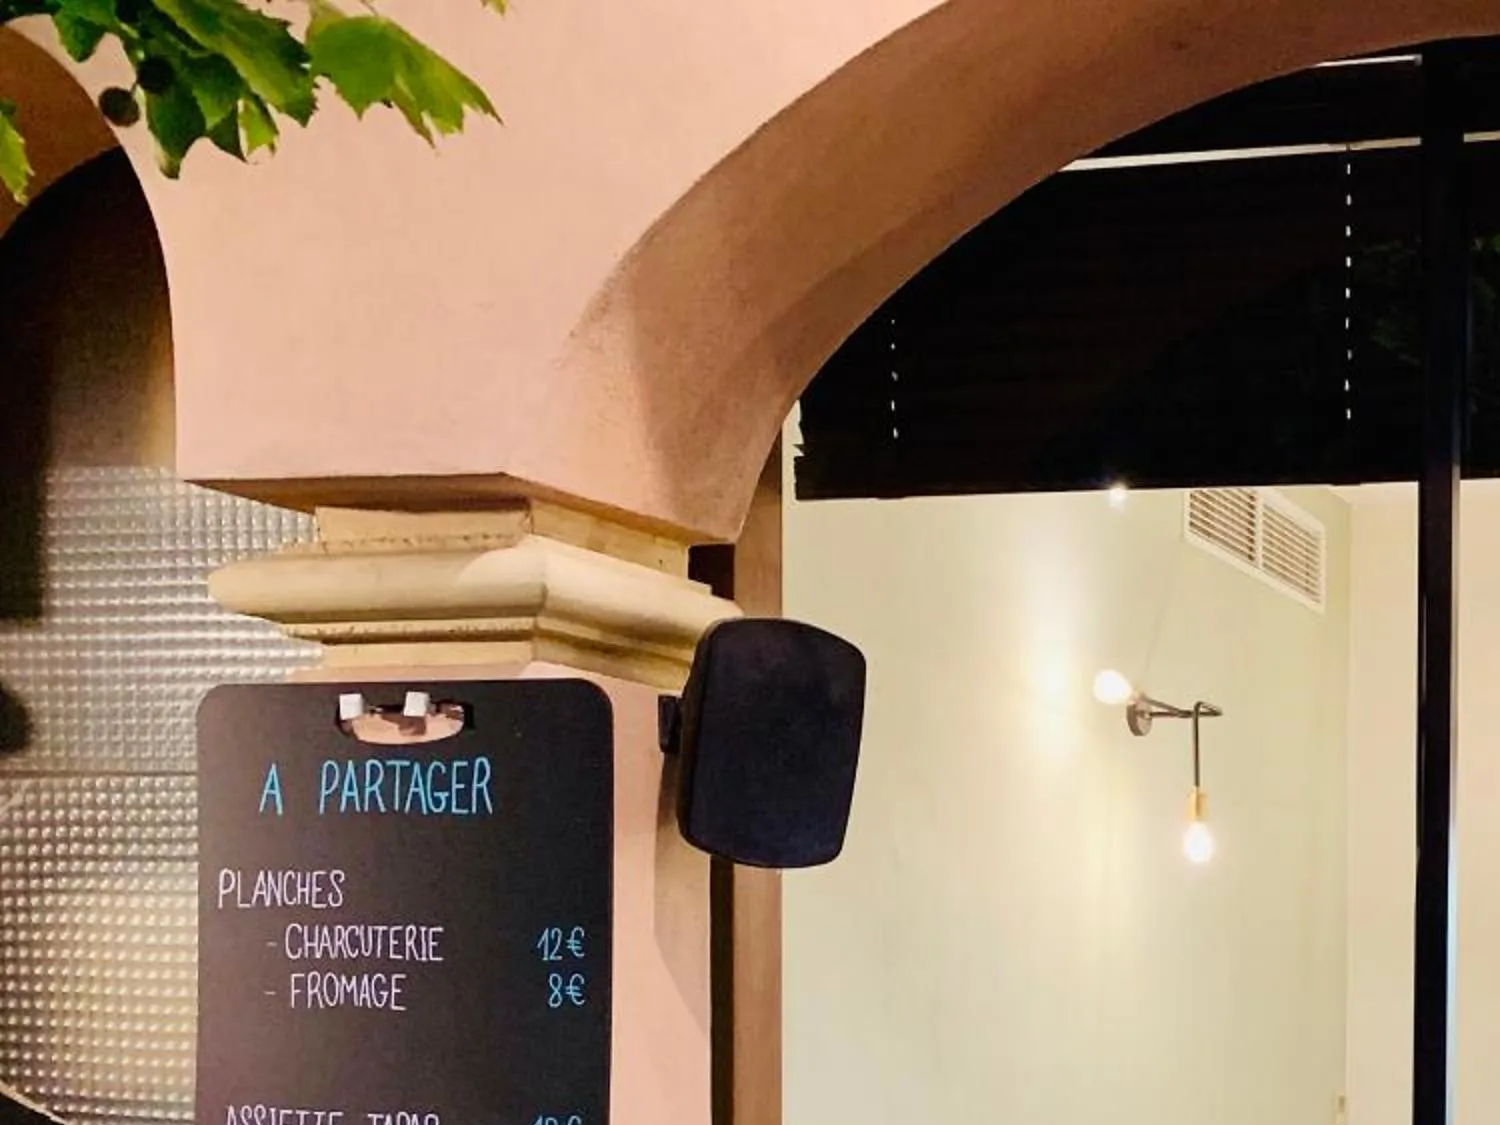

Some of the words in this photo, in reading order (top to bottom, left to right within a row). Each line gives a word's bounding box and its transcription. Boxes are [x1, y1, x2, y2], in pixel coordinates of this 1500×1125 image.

[260, 764, 283, 815] A
[319, 757, 492, 814] PARTAGER
[218, 869, 345, 910] PLANCHES
[285, 924, 444, 961] CHARCUTERIE
[290, 973, 407, 1010] FROMAGE
